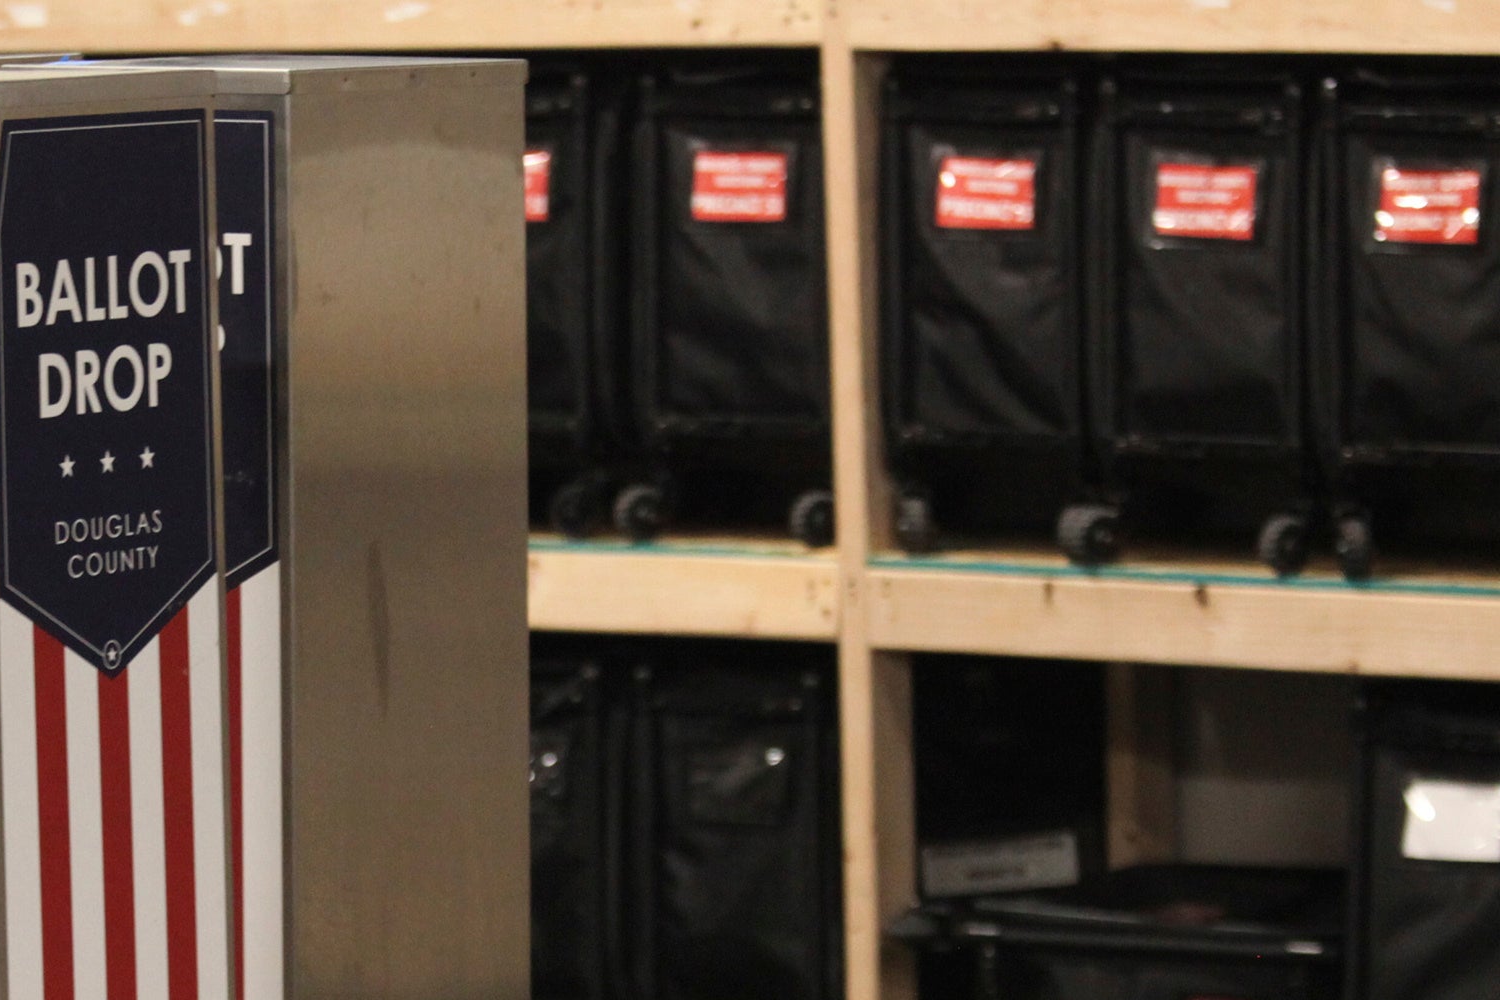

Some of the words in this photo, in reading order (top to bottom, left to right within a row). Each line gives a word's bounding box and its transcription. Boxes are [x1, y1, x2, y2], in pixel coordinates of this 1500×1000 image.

[15, 249, 192, 329] BALLOT
[38, 342, 173, 420] DROP
[54, 508, 164, 545] DOUGLAS
[66, 545, 160, 579] COUNTY
